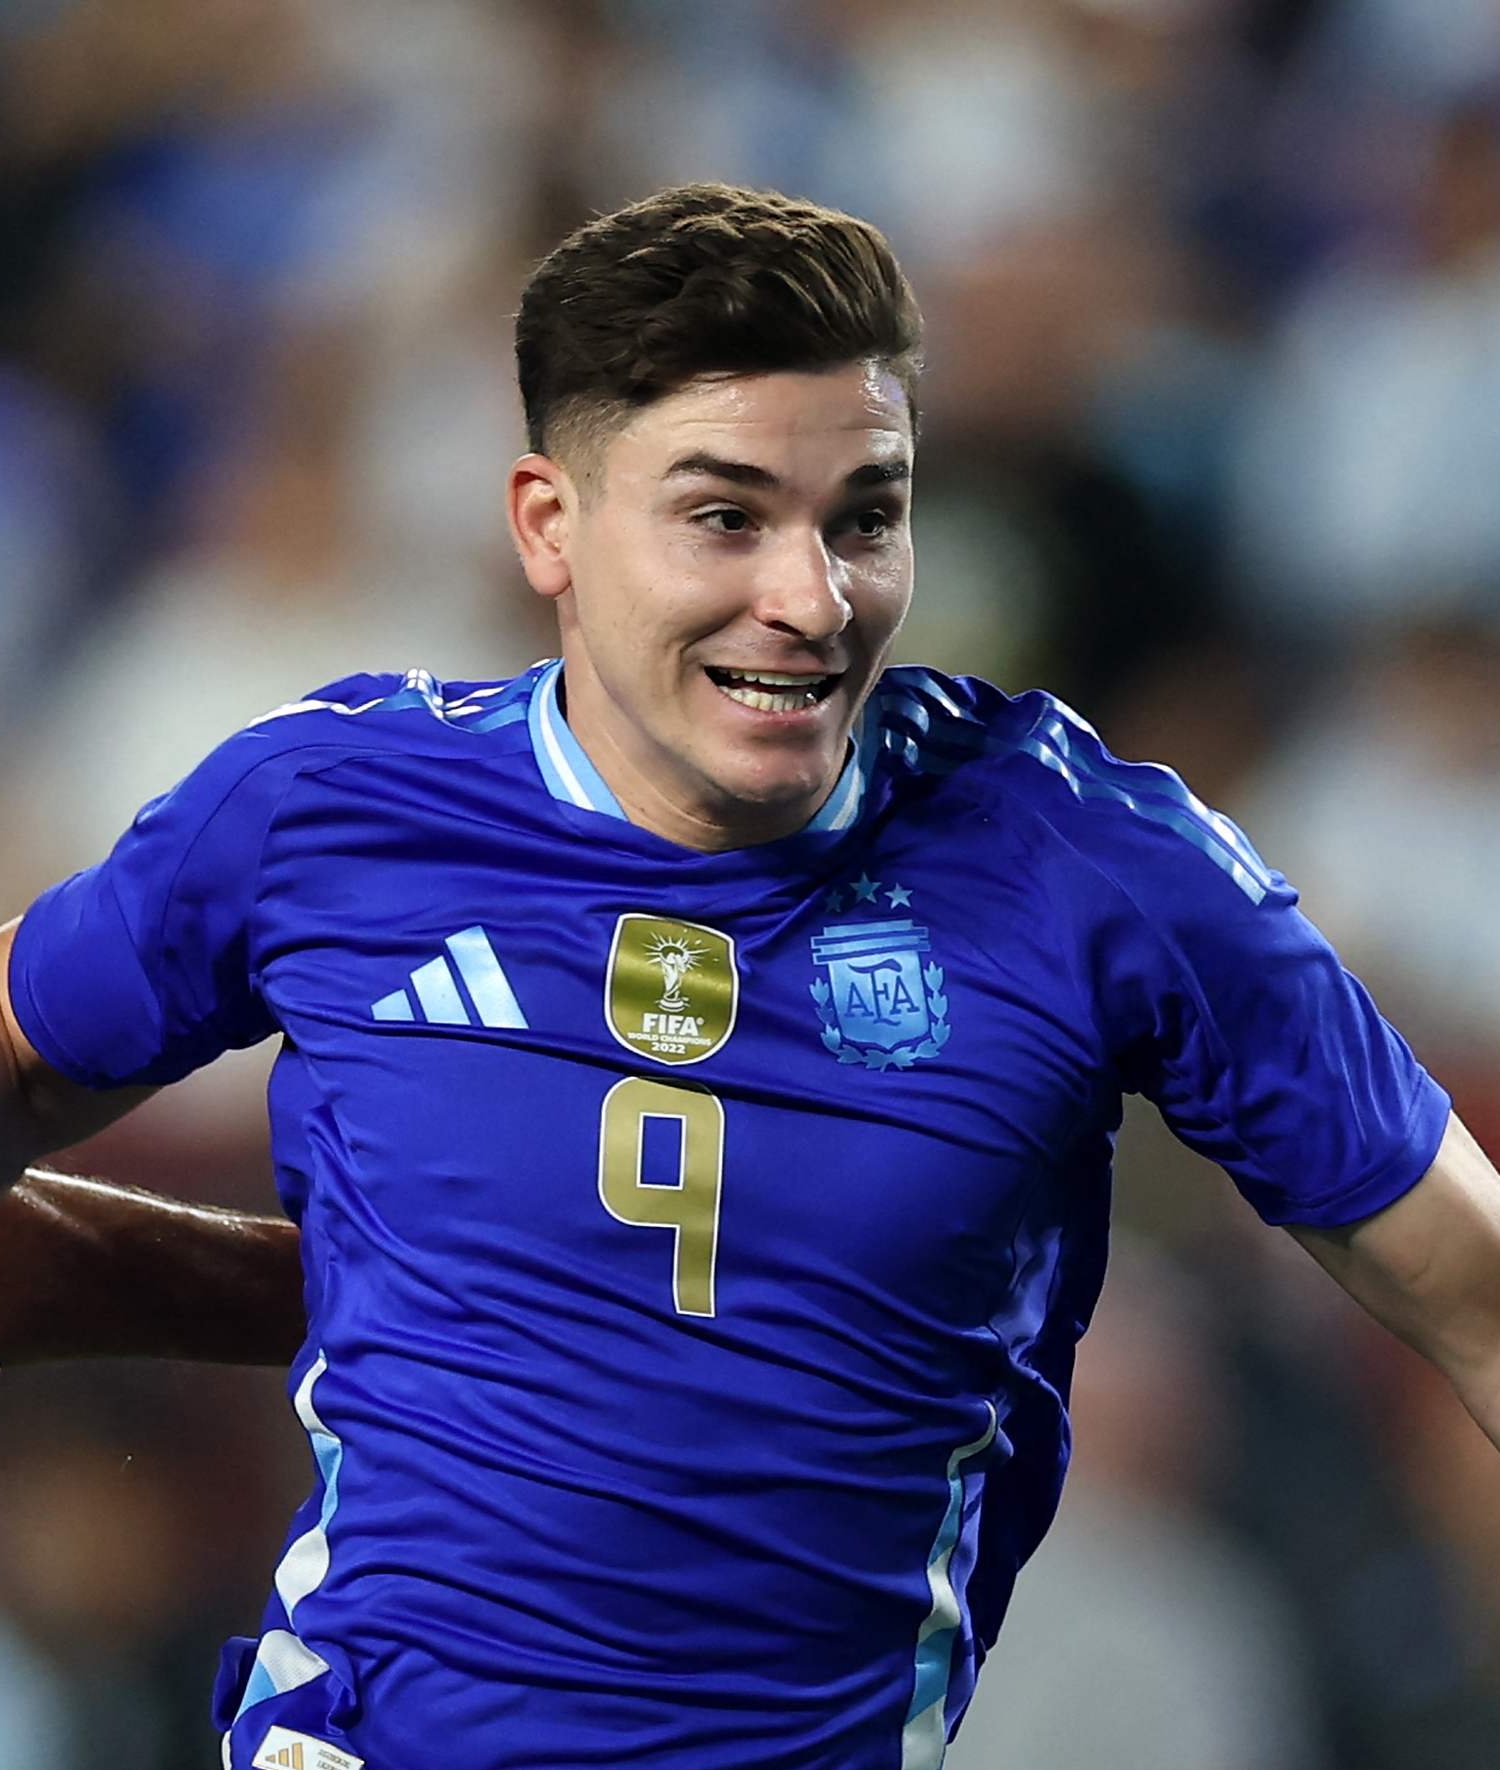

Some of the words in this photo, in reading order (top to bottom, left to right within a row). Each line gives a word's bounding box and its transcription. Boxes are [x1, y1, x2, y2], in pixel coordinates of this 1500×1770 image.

[844, 958, 921, 1026] AFA
[643, 1013, 699, 1036] FIFA
[627, 1032, 659, 1042] WORLD
[660, 1034, 712, 1046] CHAMPIONS
[651, 1042, 686, 1055] 2022
[598, 1075, 726, 1318] 9
